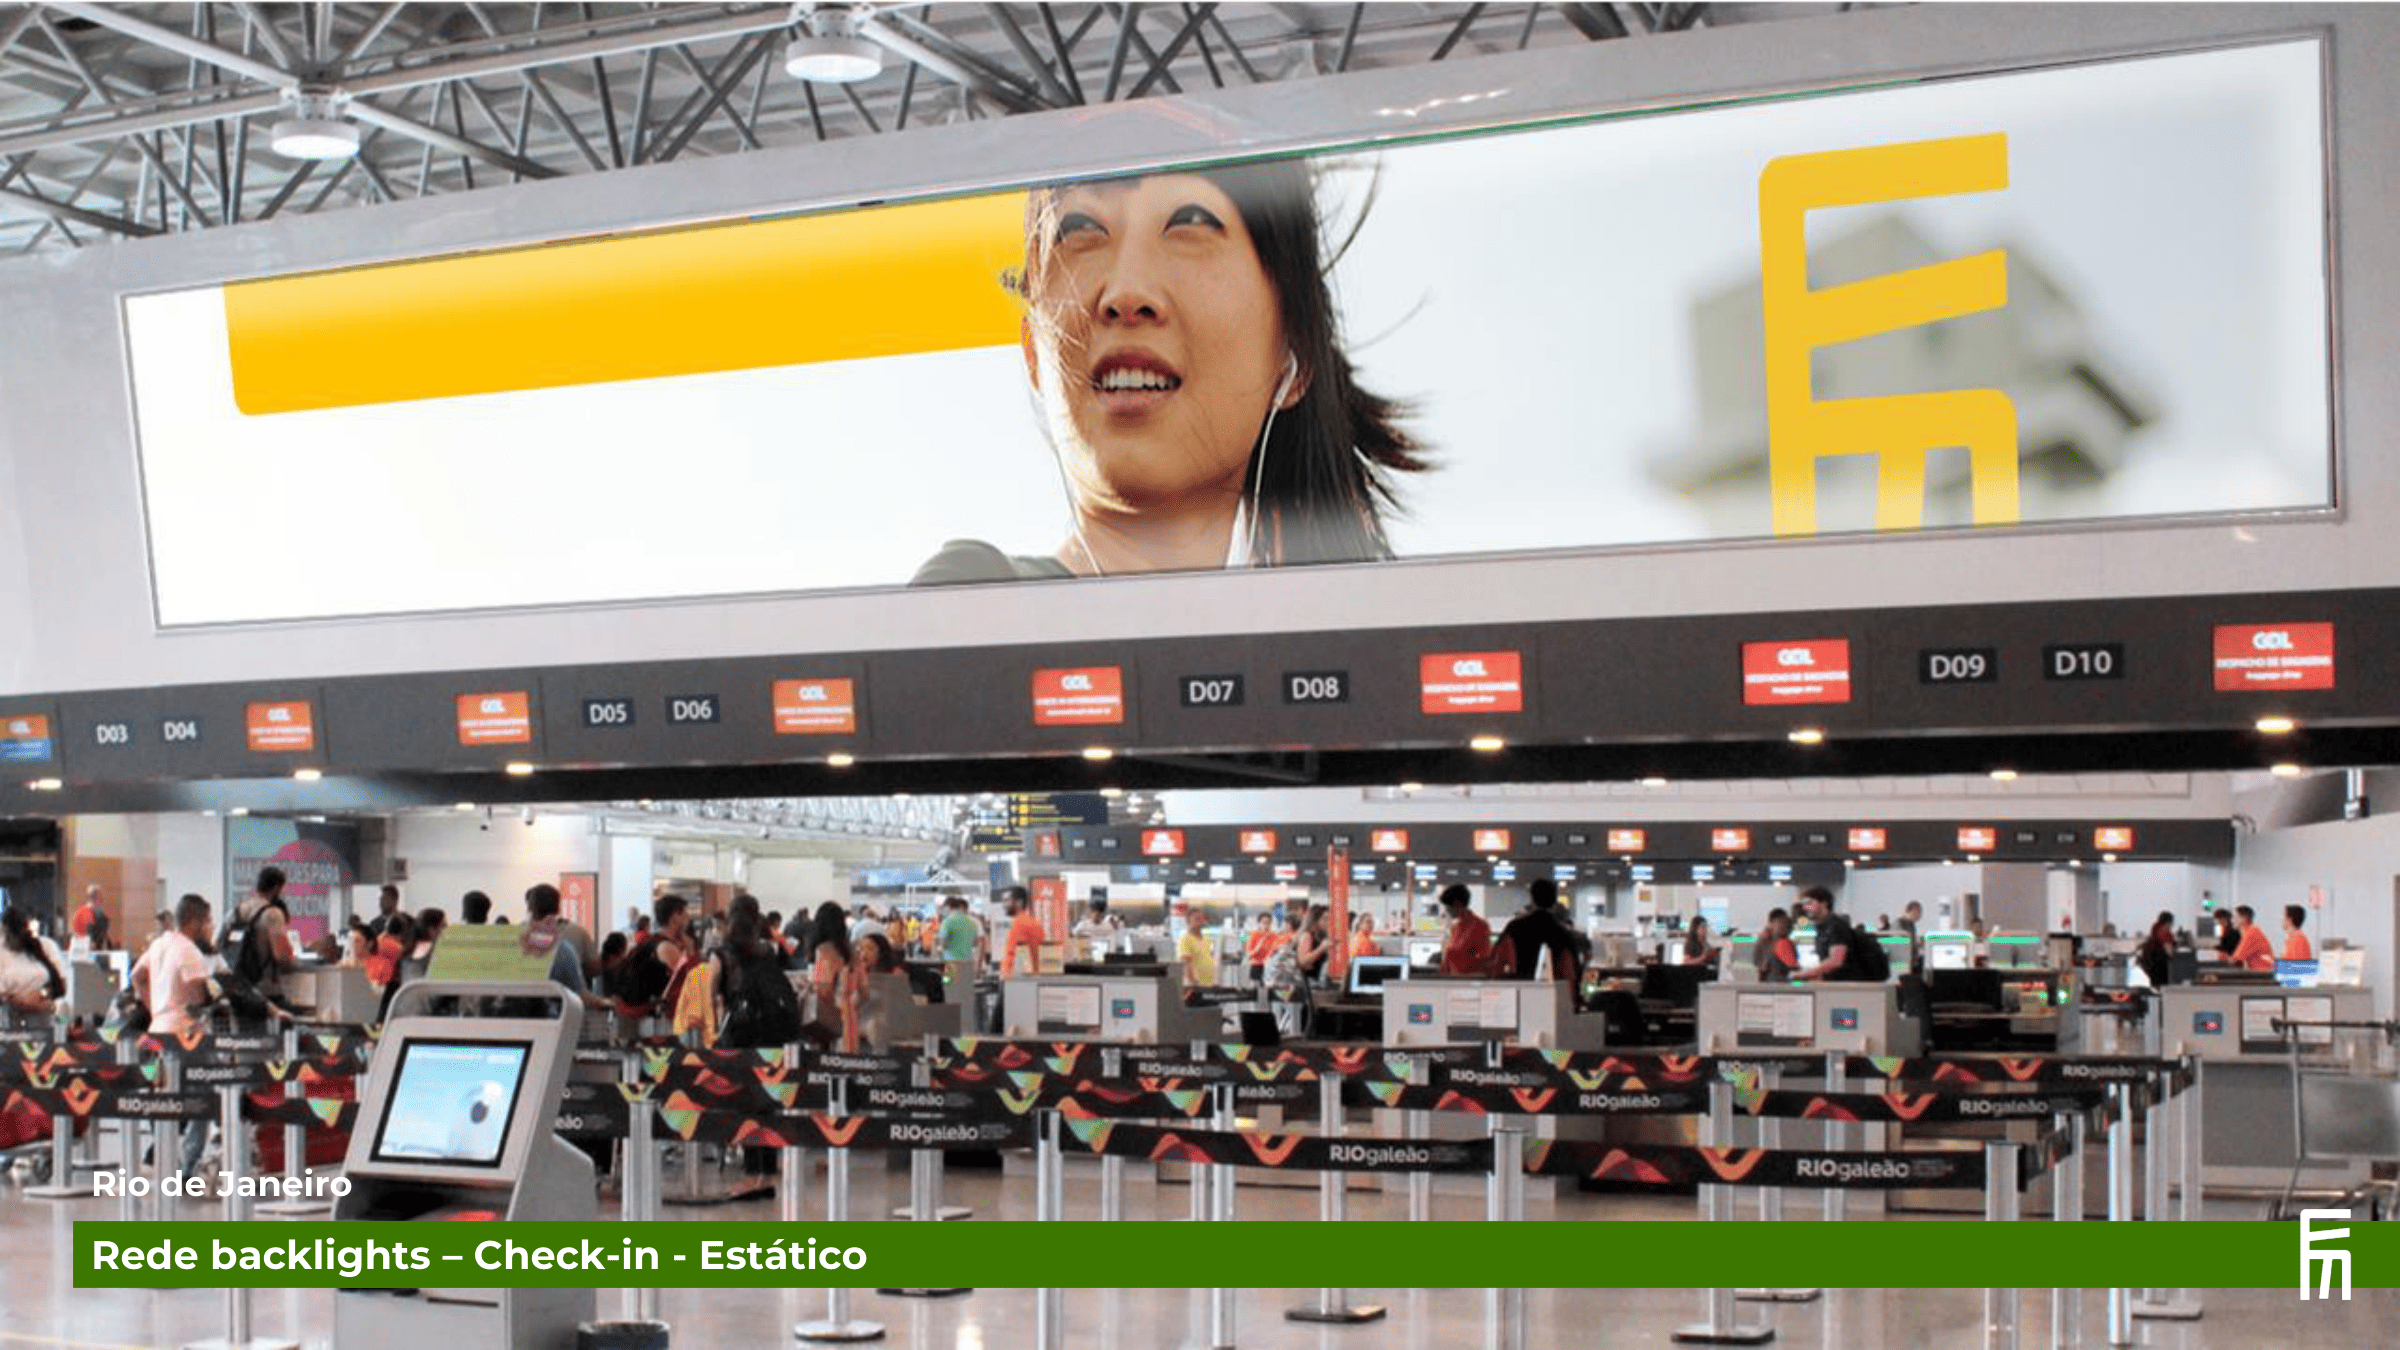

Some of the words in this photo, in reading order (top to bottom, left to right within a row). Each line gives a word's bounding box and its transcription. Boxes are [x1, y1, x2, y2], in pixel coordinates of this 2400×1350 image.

[2252, 631, 2294, 650] GOL
[1777, 648, 1816, 666] GOL
[1930, 654, 1986, 679] D09
[2055, 650, 2113, 675] D10
[1189, 680, 1235, 703] D07
[1292, 677, 1340, 700] D08
[590, 703, 628, 724] D05
[673, 700, 713, 720] D06
[97, 724, 128, 744] D03
[165, 721, 197, 740] D04
[1450, 1068, 1521, 1086] RIOgaleão
[870, 1089, 945, 1108] RIOgaleão
[1579, 1094, 1661, 1111] RIOgaleão
[1960, 1099, 2049, 1116] RIOgaleão
[890, 1124, 979, 1144] RIOgaleão
[1330, 1145, 1430, 1166] RIOgaleão
[1797, 1159, 1910, 1180] RIOgaleão
